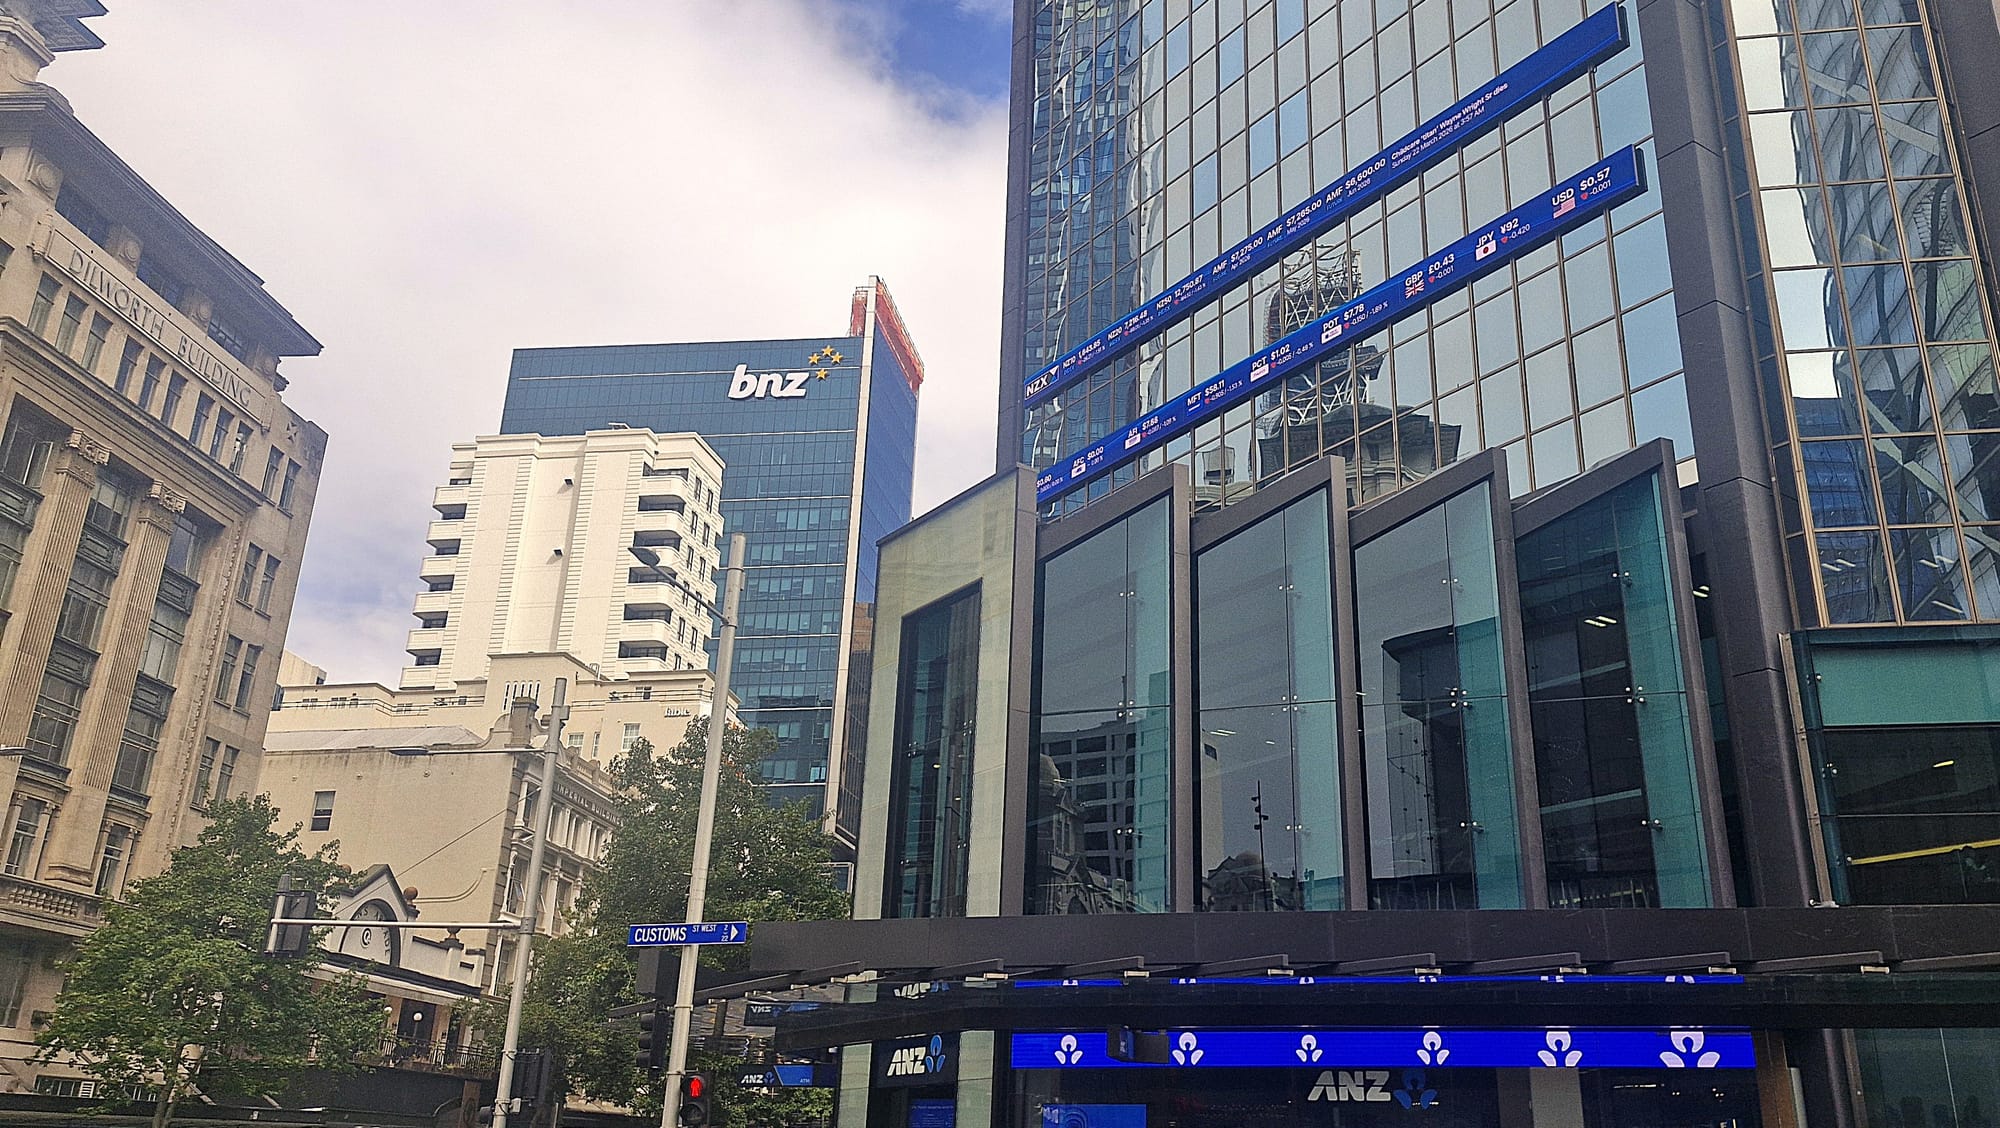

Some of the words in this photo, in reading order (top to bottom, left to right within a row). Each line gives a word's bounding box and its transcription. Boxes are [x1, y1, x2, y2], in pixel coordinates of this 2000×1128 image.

[1391, 138, 1421, 160] Childcare
[1440, 112, 1462, 130] Wayne
[1462, 98, 1485, 117] Wright
[1485, 91, 1494, 101] Sr
[1494, 82, 1509, 97] dies
[1391, 153, 1412, 169] Sunday
[1412, 148, 1420, 156] 22
[1420, 137, 1438, 151] March
[1438, 127, 1454, 140] 2026
[1454, 122, 1461, 130] at
[1474, 106, 1485, 117] AM
[1326, 186, 1344, 203] AMF
[1345, 159, 1386, 190] $6,600.00
[1347, 187, 1357, 198] Jun
[1357, 178, 1371, 190] 2026
[1552, 188, 1575, 206] USD
[1580, 167, 1610, 191] $0.57
[1590, 180, 1611, 195] -0.001
[1267, 224, 1283, 240] AMF
[1286, 199, 1322, 227] $7,265.00
[1287, 225, 1297, 236] May
[1298, 217, 1310, 229] 2026
[1476, 231, 1494, 248] JPY
[1500, 218, 1519, 234] ¥92
[1509, 223, 1530, 239] -0.420
[1212, 260, 1228, 275] AMF
[1230, 236, 1263, 263] $7,275.00
[1239, 255, 1251, 266] 2026
[1405, 271, 1423, 287] GBP
[1428, 254, 1455, 274] £0.43
[1435, 265, 1454, 280] -0.001
[1156, 295, 1172, 311] NZ50
[68, 248, 165, 341] DILWORTH
[177, 334, 252, 407] BUILDING
[1323, 317, 1340, 332] POT
[1343, 303, 1365, 321] $7.78
[1252, 356, 1267, 371] PCT
[1271, 344, 1290, 361] $1.02
[727, 363, 810, 399] bnz
[1026, 374, 1048, 397] NZX
[1187, 392, 1202, 407] MFT
[1204, 379, 1225, 397] $58.11
[1087, 446, 1104, 461] $0.00
[556, 783, 589, 808] IMPERIAL
[634, 927, 688, 943] CUSTOMS
[692, 925, 699, 933] ST
[701, 924, 717, 932] WEST
[887, 1046, 927, 1077] ANZ
[740, 1074, 764, 1084] ANZ
[1307, 1070, 1392, 1101] ANZ
